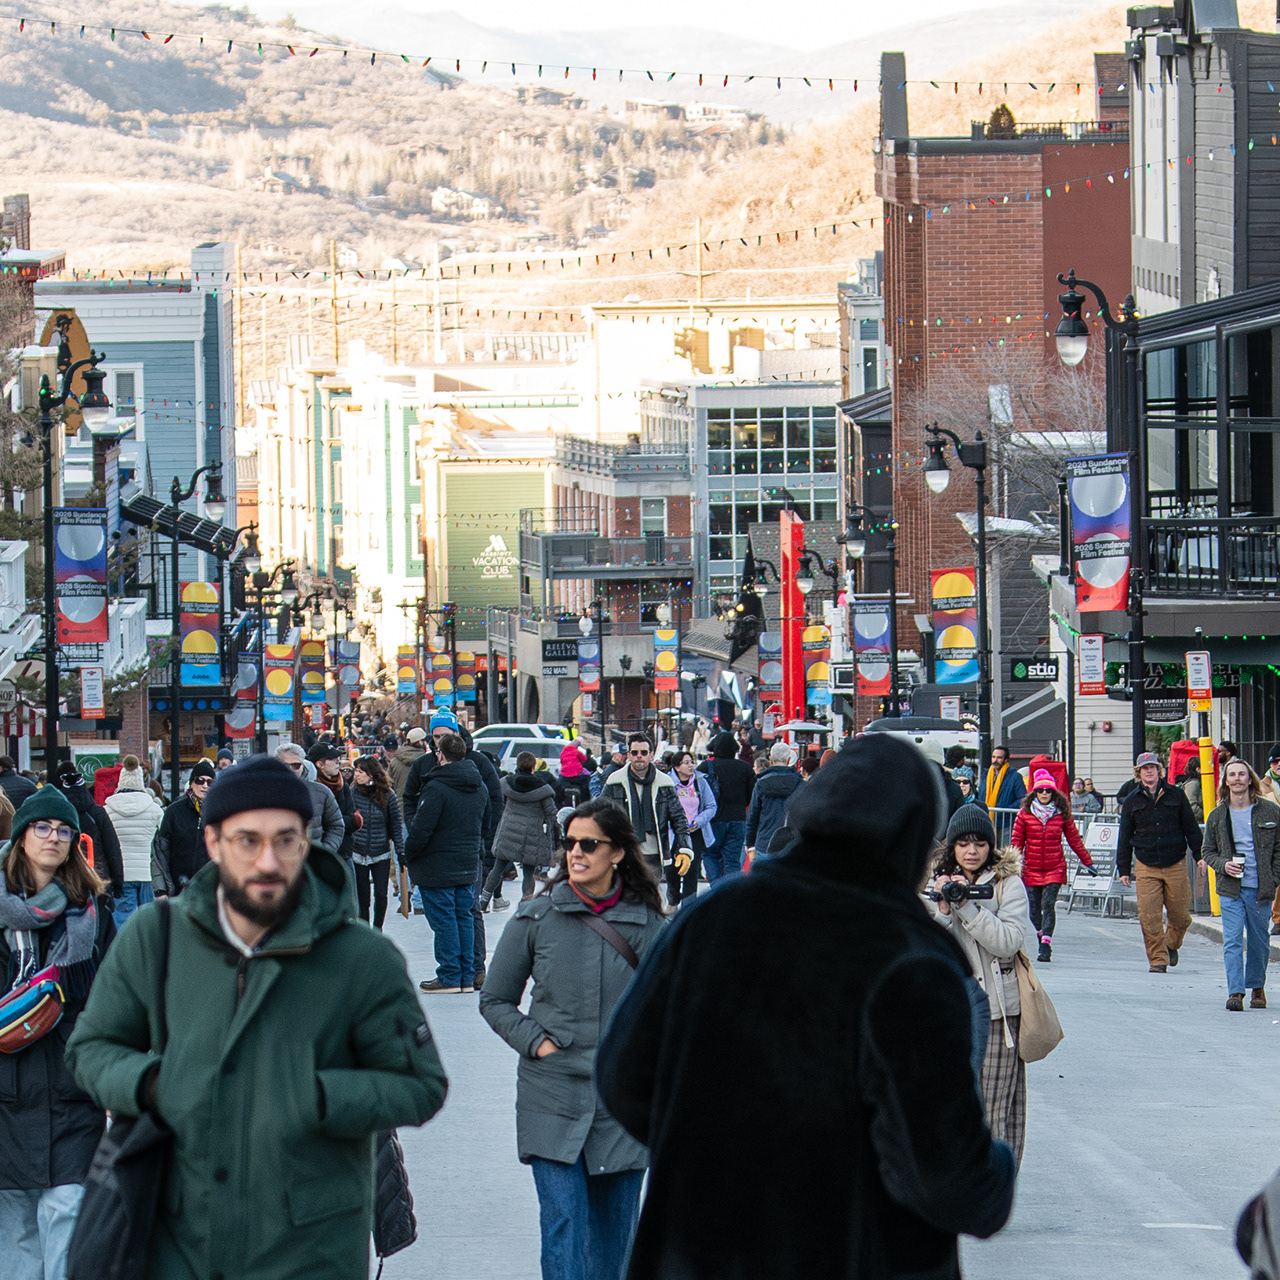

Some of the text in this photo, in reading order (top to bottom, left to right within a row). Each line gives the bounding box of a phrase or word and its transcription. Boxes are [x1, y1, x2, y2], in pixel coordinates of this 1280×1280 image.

[1068, 458, 1128, 470] 2026 Sundance
[1073, 465, 1122, 476] Film Festival
[1074, 542, 1130, 552] 2026 Sundance
[1080, 548, 1124, 558] Film Festival
[472, 557, 520, 565] VACATION
[483, 566, 509, 575] CLUB
[545, 648, 577, 657] GALLER
[1028, 663, 1056, 676] stio
